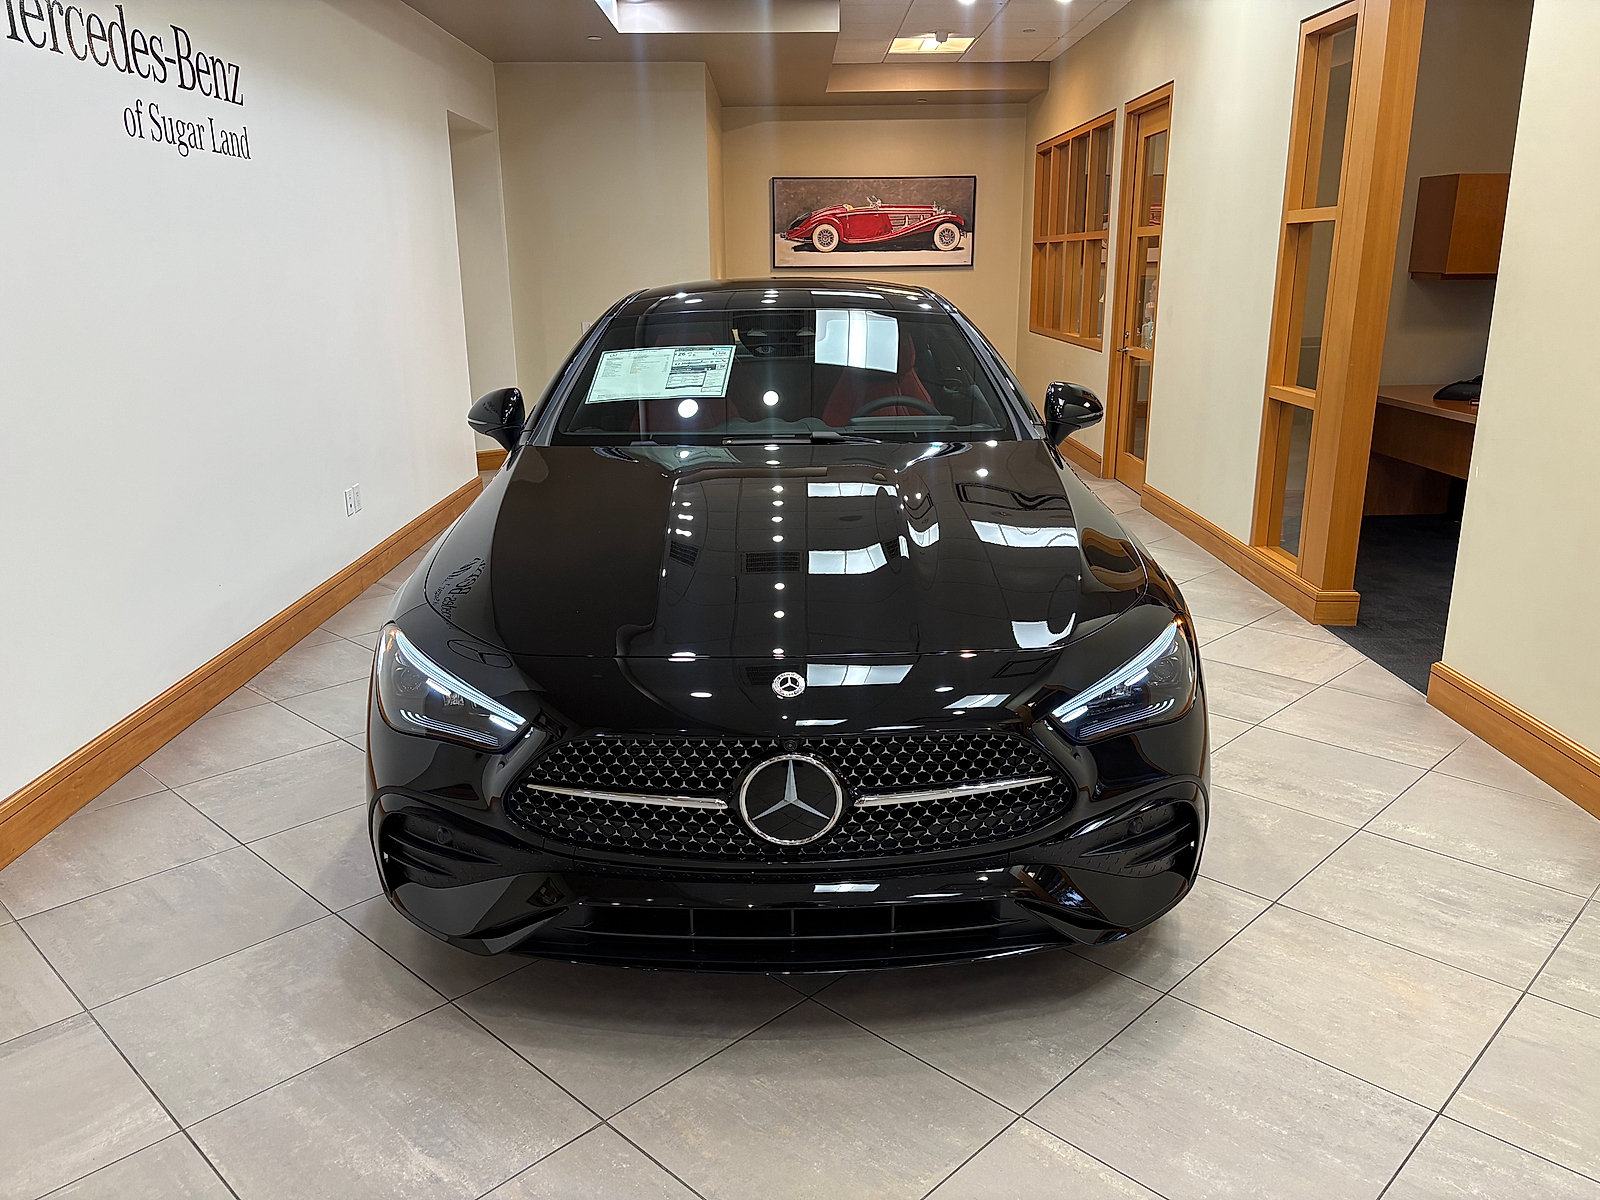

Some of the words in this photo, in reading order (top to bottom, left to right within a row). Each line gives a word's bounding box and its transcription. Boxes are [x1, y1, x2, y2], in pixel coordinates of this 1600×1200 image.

[123, 98, 145, 139] of
[148, 102, 205, 157] Sugar
[207, 116, 251, 160] Land
